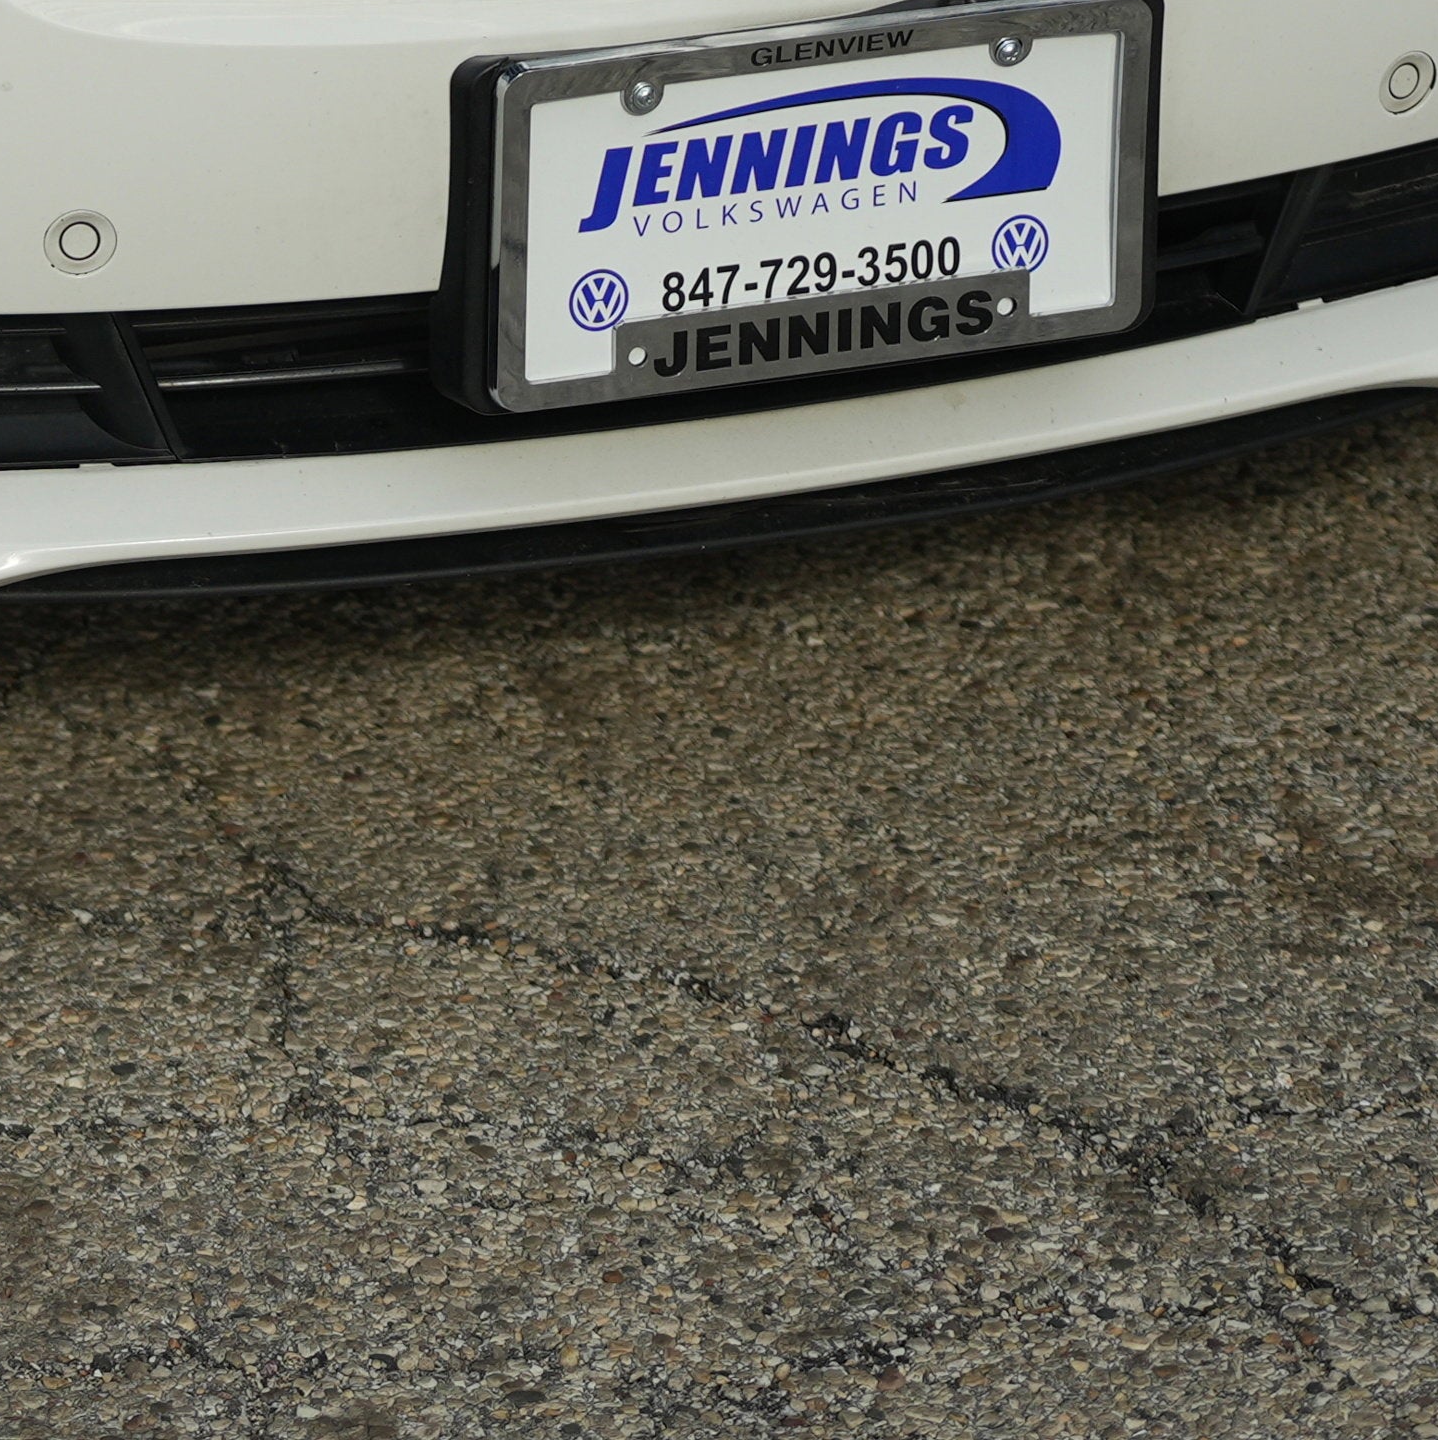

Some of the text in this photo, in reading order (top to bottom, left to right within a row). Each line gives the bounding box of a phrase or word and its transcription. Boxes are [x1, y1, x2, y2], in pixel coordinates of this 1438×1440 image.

[750, 28, 915, 68] GLENVIEW
[578, 104, 974, 233] JENNINGS
[633, 180, 919, 238] VOLKSWAGEN
[662, 236, 961, 314] 847-729-3500
[653, 289, 994, 378] JENNINGS
